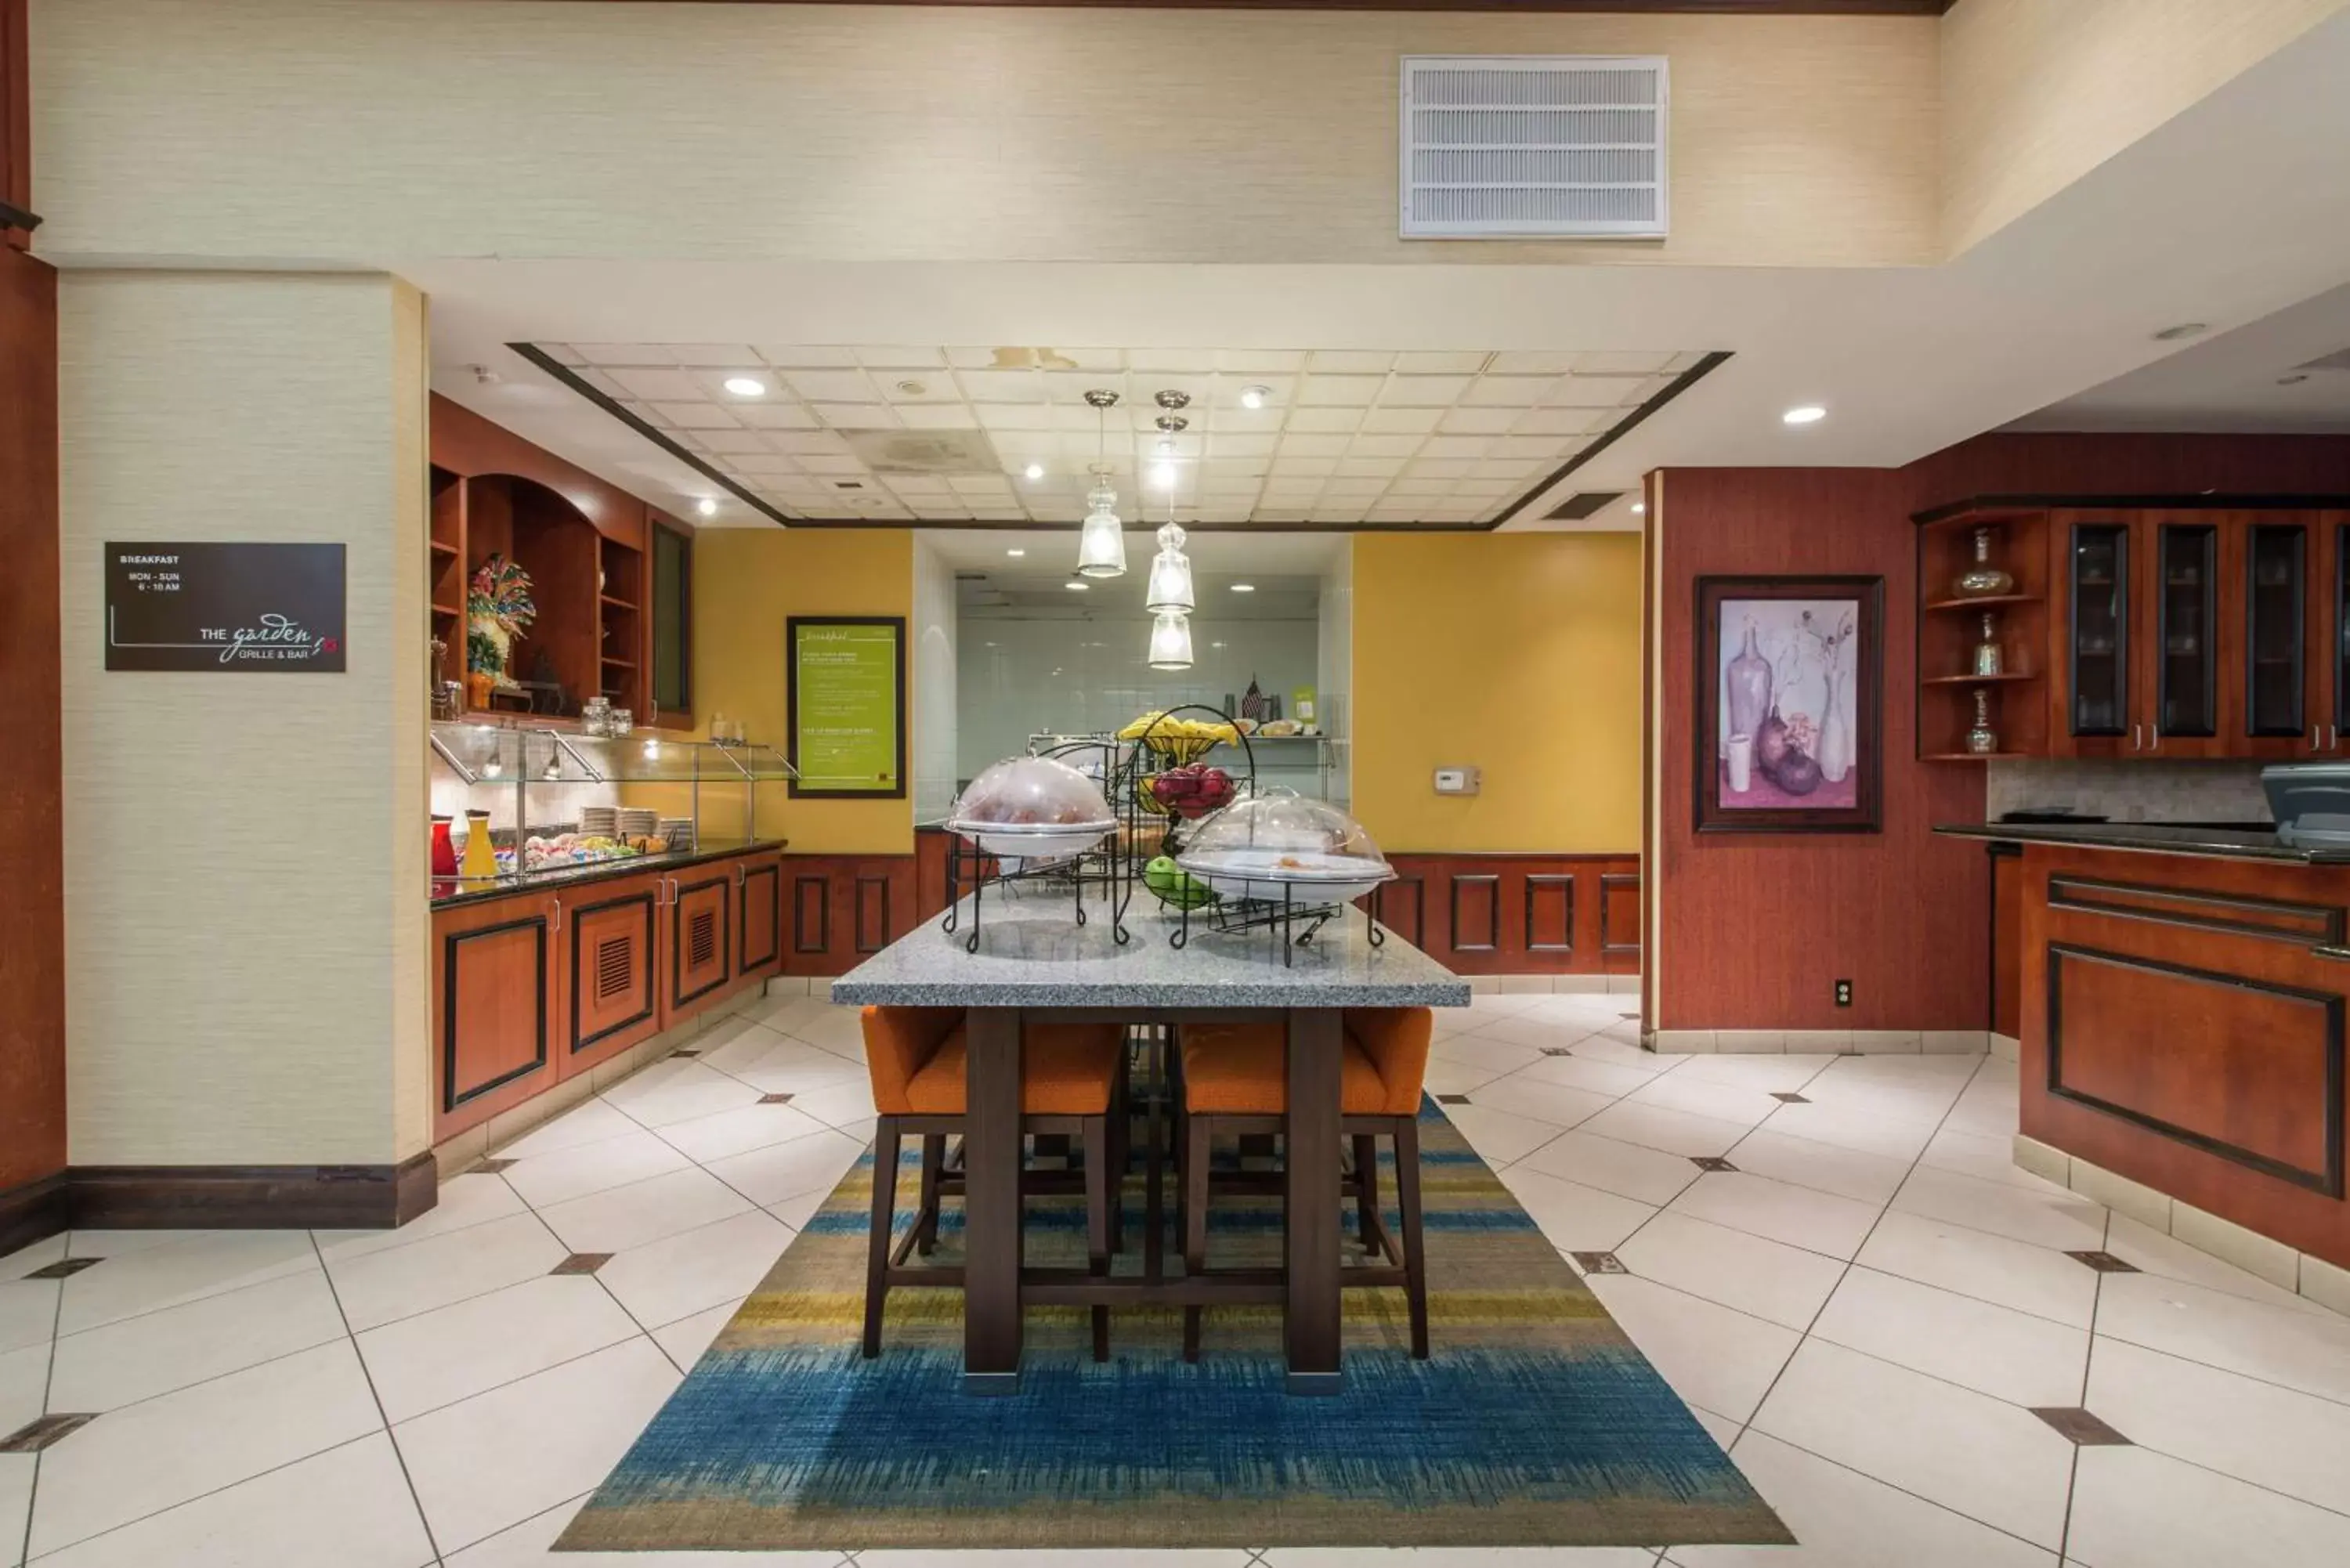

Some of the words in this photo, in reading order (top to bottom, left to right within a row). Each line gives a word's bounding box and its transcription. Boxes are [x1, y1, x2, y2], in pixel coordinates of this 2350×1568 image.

[120, 555, 179, 564] BREAKFAST
[201, 629, 226, 640] THE
[219, 613, 311, 663] garden
[239, 650, 274, 659] GRILLE
[277, 650, 284, 659] &
[287, 650, 308, 659] BAR
